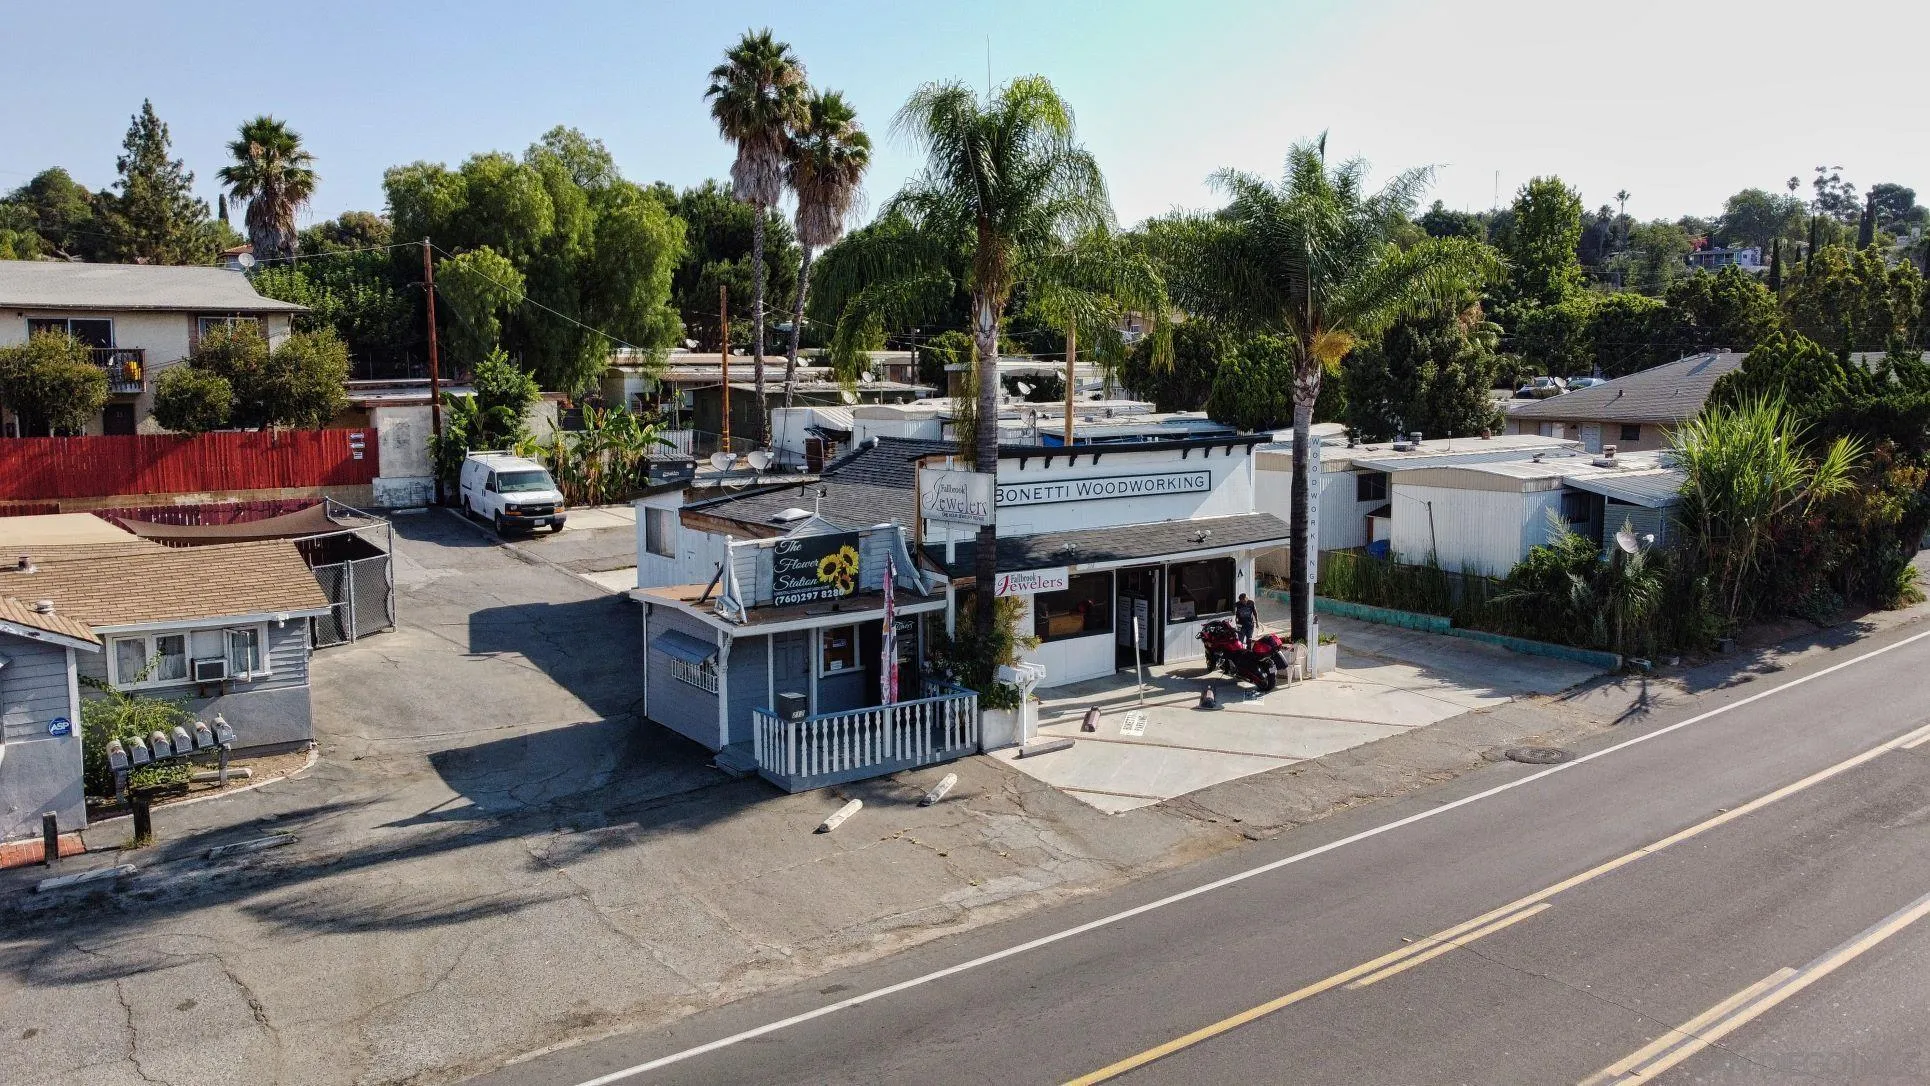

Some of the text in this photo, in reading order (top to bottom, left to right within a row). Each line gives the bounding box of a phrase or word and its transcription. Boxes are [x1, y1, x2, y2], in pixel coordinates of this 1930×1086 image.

[922, 474, 987, 515] Jewelers
[996, 476, 1205, 503] BONETTI WOODWORKING
[1309, 437, 1320, 580] WOODWORKING
[775, 540, 802, 554] The
[774, 558, 819, 573] Flower
[772, 575, 818, 591] Station
[995, 575, 1063, 596] Jewelers
[1011, 572, 1035, 583] Fallbrook
